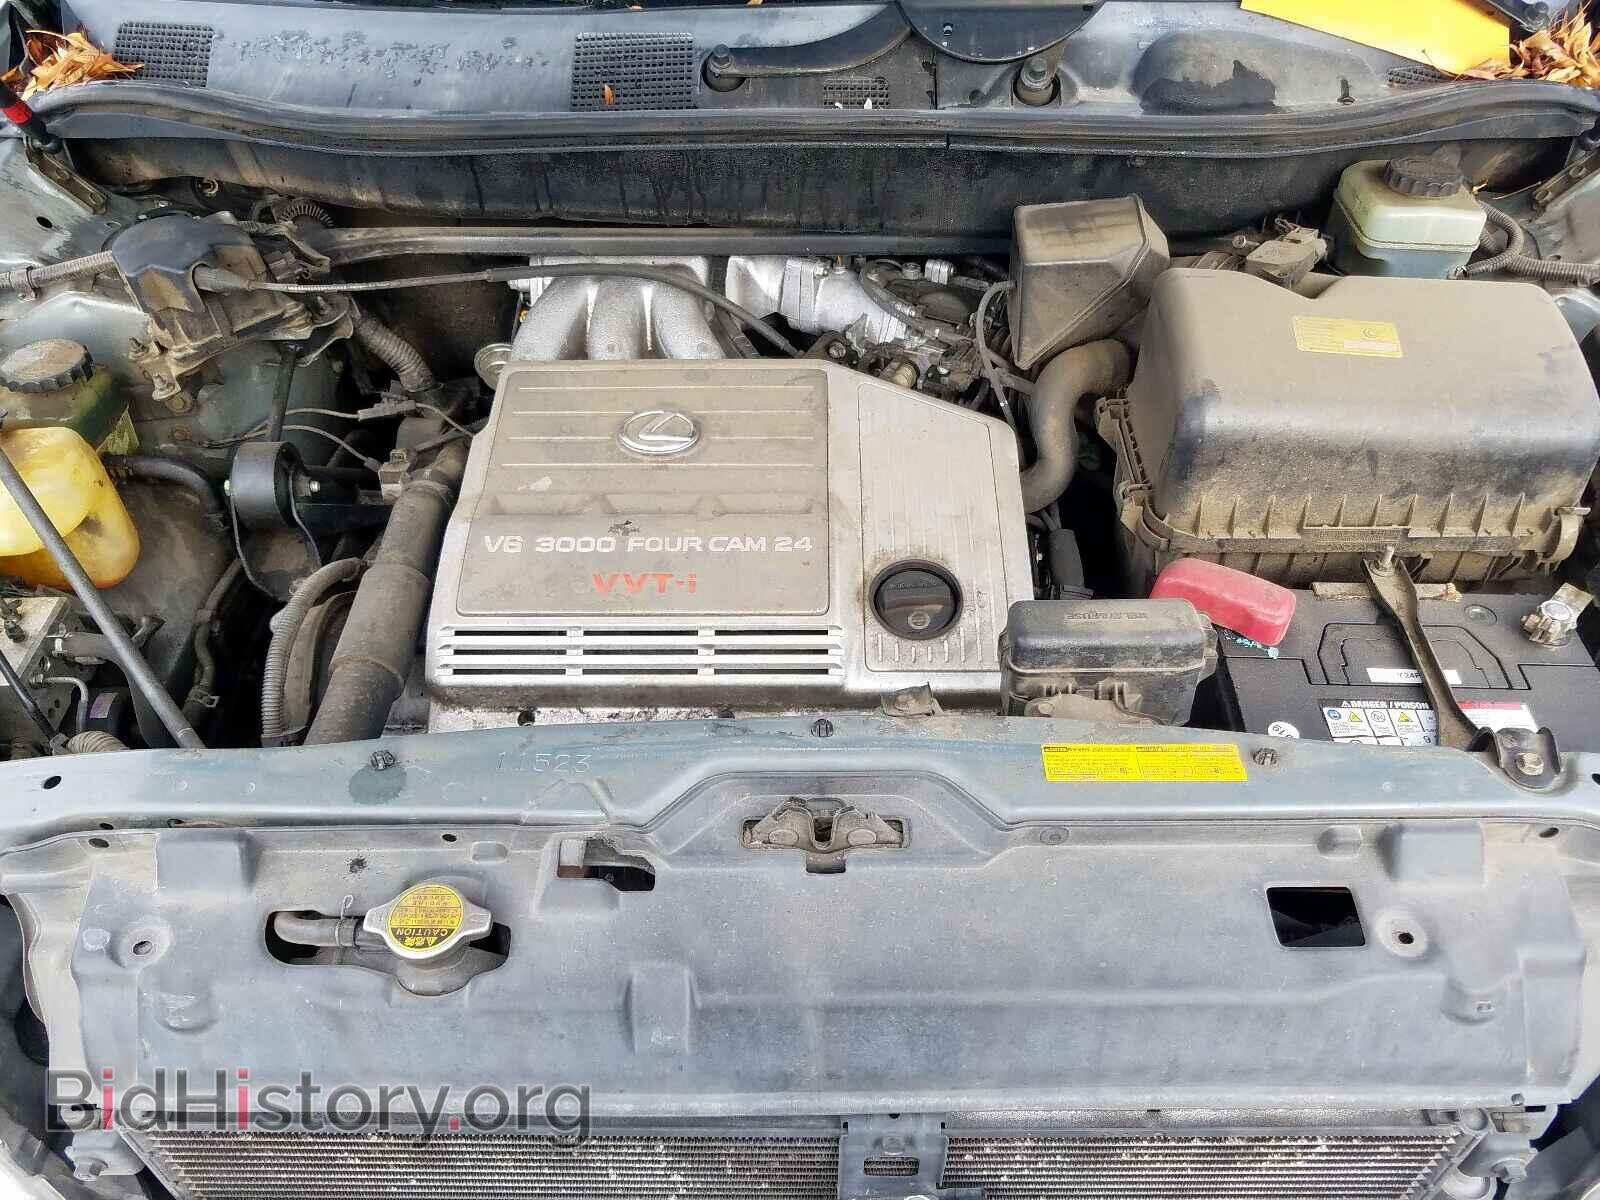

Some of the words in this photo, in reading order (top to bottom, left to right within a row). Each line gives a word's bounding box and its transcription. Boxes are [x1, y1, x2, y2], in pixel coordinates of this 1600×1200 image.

[484, 535, 523, 553] V6
[535, 536, 616, 553] 3000
[627, 536, 703, 552] FOUR
[708, 536, 767, 552] CAM
[774, 536, 813, 552] 24
[592, 571, 697, 595] VVT-i
[1350, 699, 1388, 709] DANGER
[396, 927, 448, 937] CAUTION
